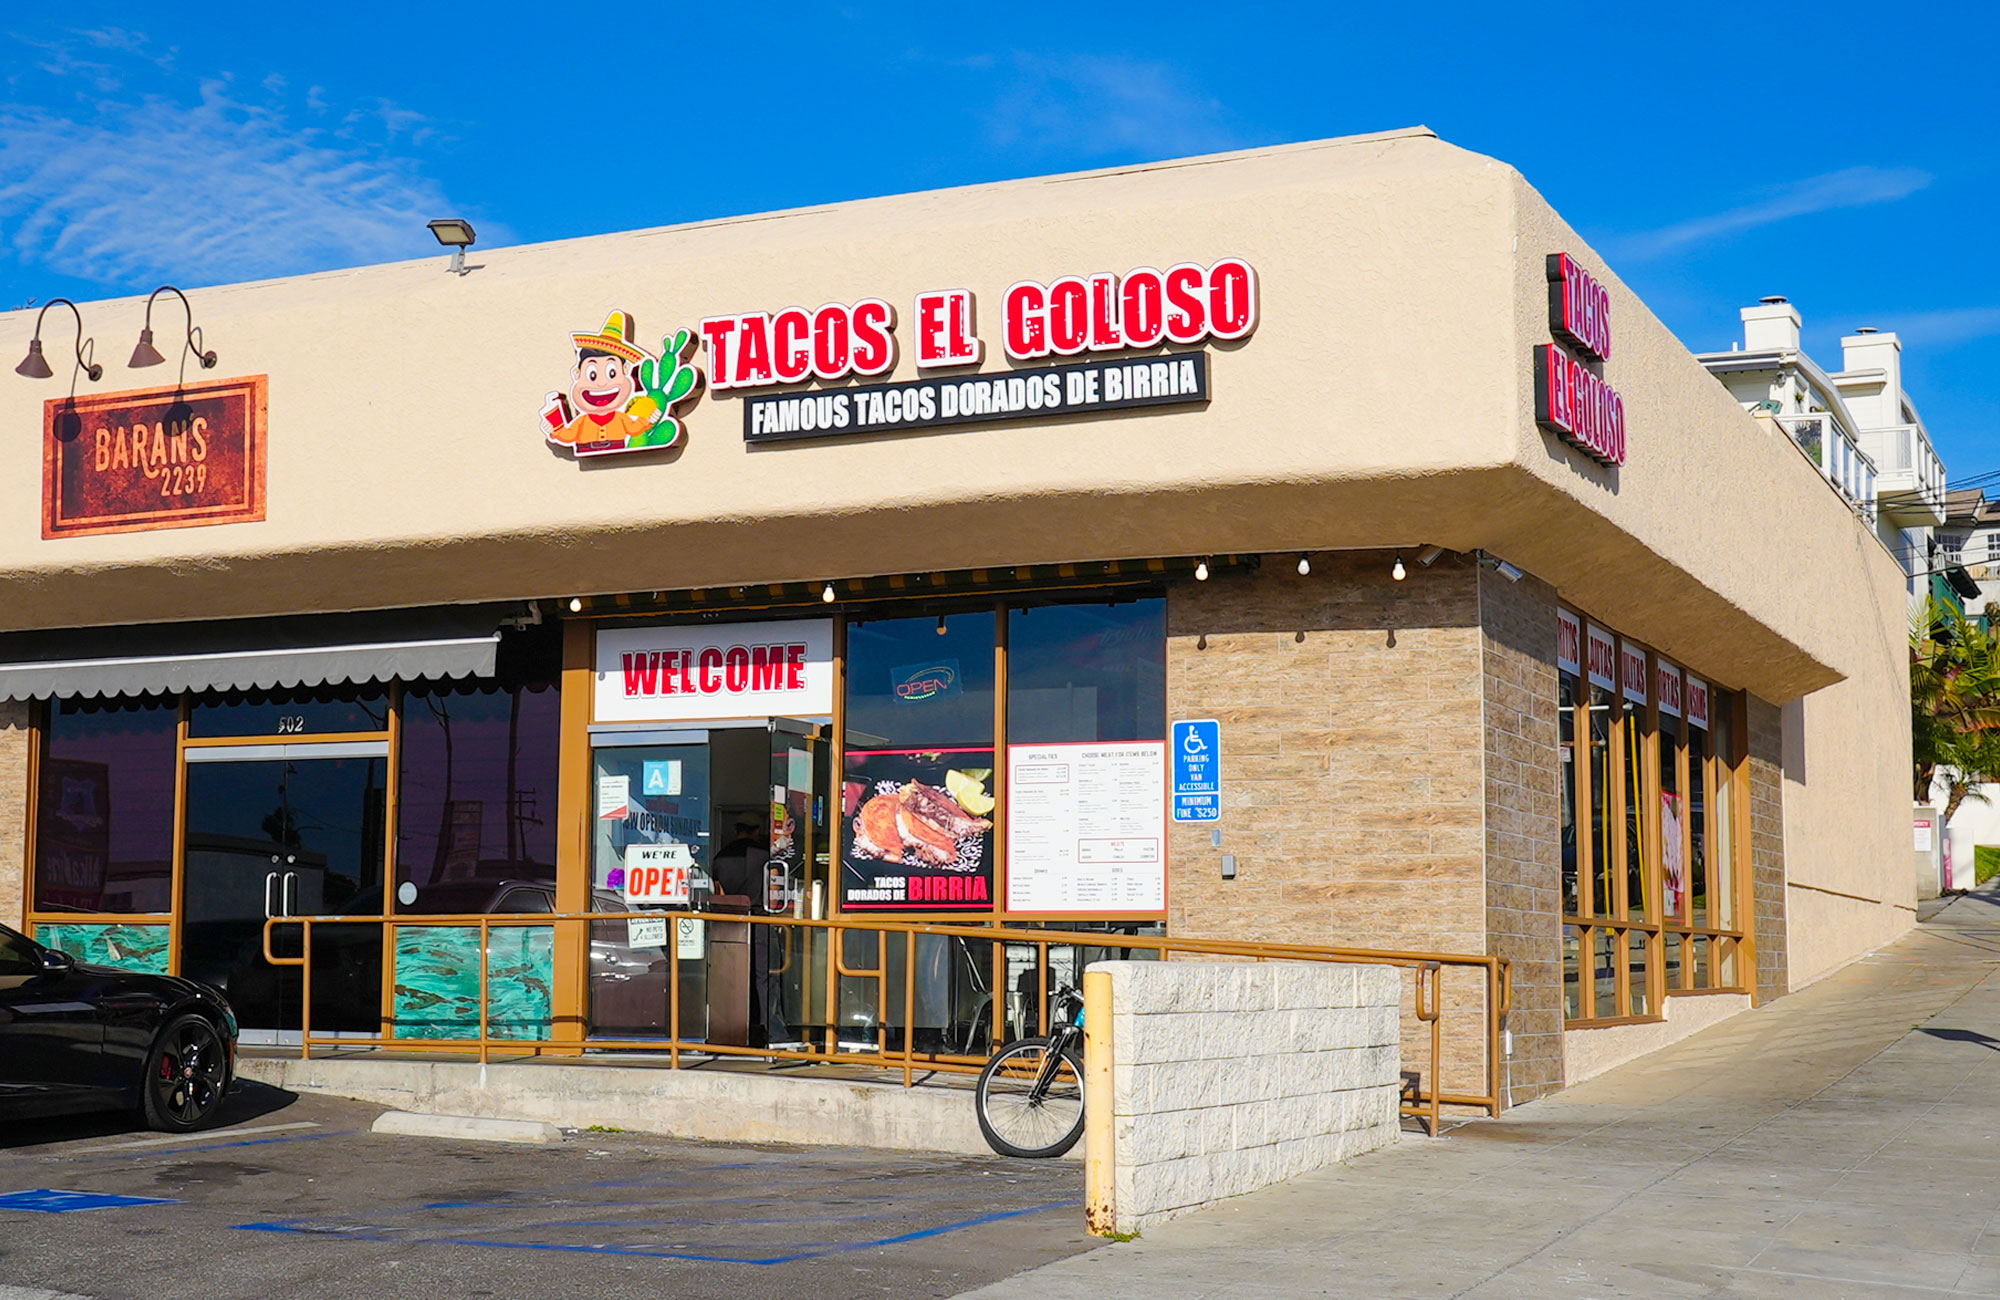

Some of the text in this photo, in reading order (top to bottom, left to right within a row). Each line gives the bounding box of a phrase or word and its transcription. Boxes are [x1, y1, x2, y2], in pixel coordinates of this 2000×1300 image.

[1564, 256, 1610, 360] TACOS
[704, 262, 1249, 384] TACOS EL GOLOSO
[752, 359, 1199, 435] FAMOUS TACOS DORADOS DE BIRRIA
[1553, 348, 1625, 462] EL GOLOSO
[161, 464, 207, 496] 2239
[623, 646, 805, 696] WELCOME
[897, 679, 947, 696] OPEN
[278, 715, 304, 734] 502
[1183, 754, 1210, 763] PARKING
[1188, 763, 1205, 772] ONLY
[648, 769, 664, 789] A
[1190, 773, 1203, 781] VAN
[1178, 781, 1215, 791] ACCESSIBLE
[1182, 796, 1212, 806] MINIMUM
[1177, 806, 1218, 819] FINE $250
[642, 851, 678, 859] WE'RE
[874, 877, 906, 888] TACOS
[908, 875, 988, 901] BIRRIA
[847, 889, 906, 901] DORADOS DE
